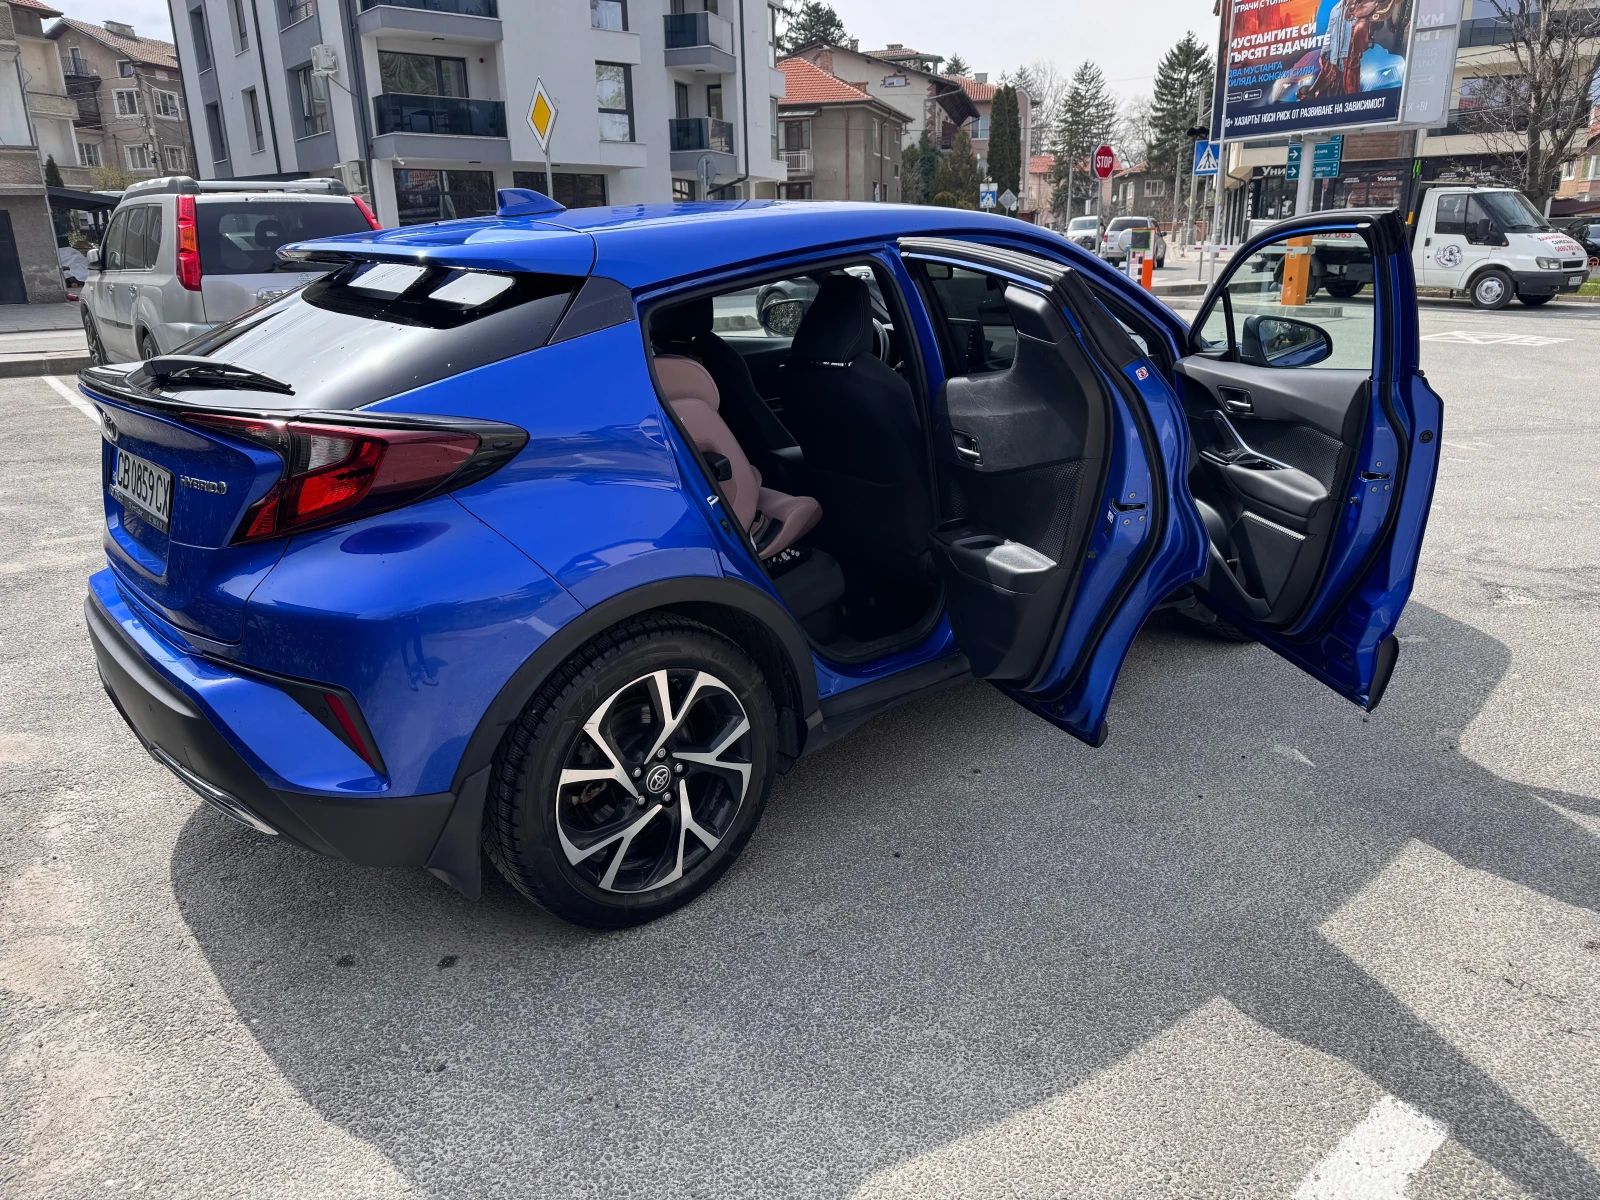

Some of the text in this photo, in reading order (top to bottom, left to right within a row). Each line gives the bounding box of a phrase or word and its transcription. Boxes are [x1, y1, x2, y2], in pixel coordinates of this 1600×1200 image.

[1300, 21, 1317, 35] СИ
[1269, 34, 1331, 56] ЕЗДАЧИТЕ
[1243, 61, 1283, 75] МУСТАНГА
[1258, 70, 1290, 83] КОНСКИ
[1291, 65, 1315, 77] СИЛИ
[1233, 114, 1261, 127] ХАЗАРТЪТ
[1261, 112, 1276, 123] НОСИ
[1276, 110, 1291, 121] РИСК
[1291, 108, 1300, 119] ОТ
[1300, 104, 1334, 118] РАЗВИВАНЕ
[1334, 103, 1343, 114] НА
[1344, 97, 1386, 112] ЗАВИСИМОСТ
[1096, 155, 1113, 168] STOP
[1261, 166, 1286, 176] Уни
[179, 474, 218, 494] HYBRID
